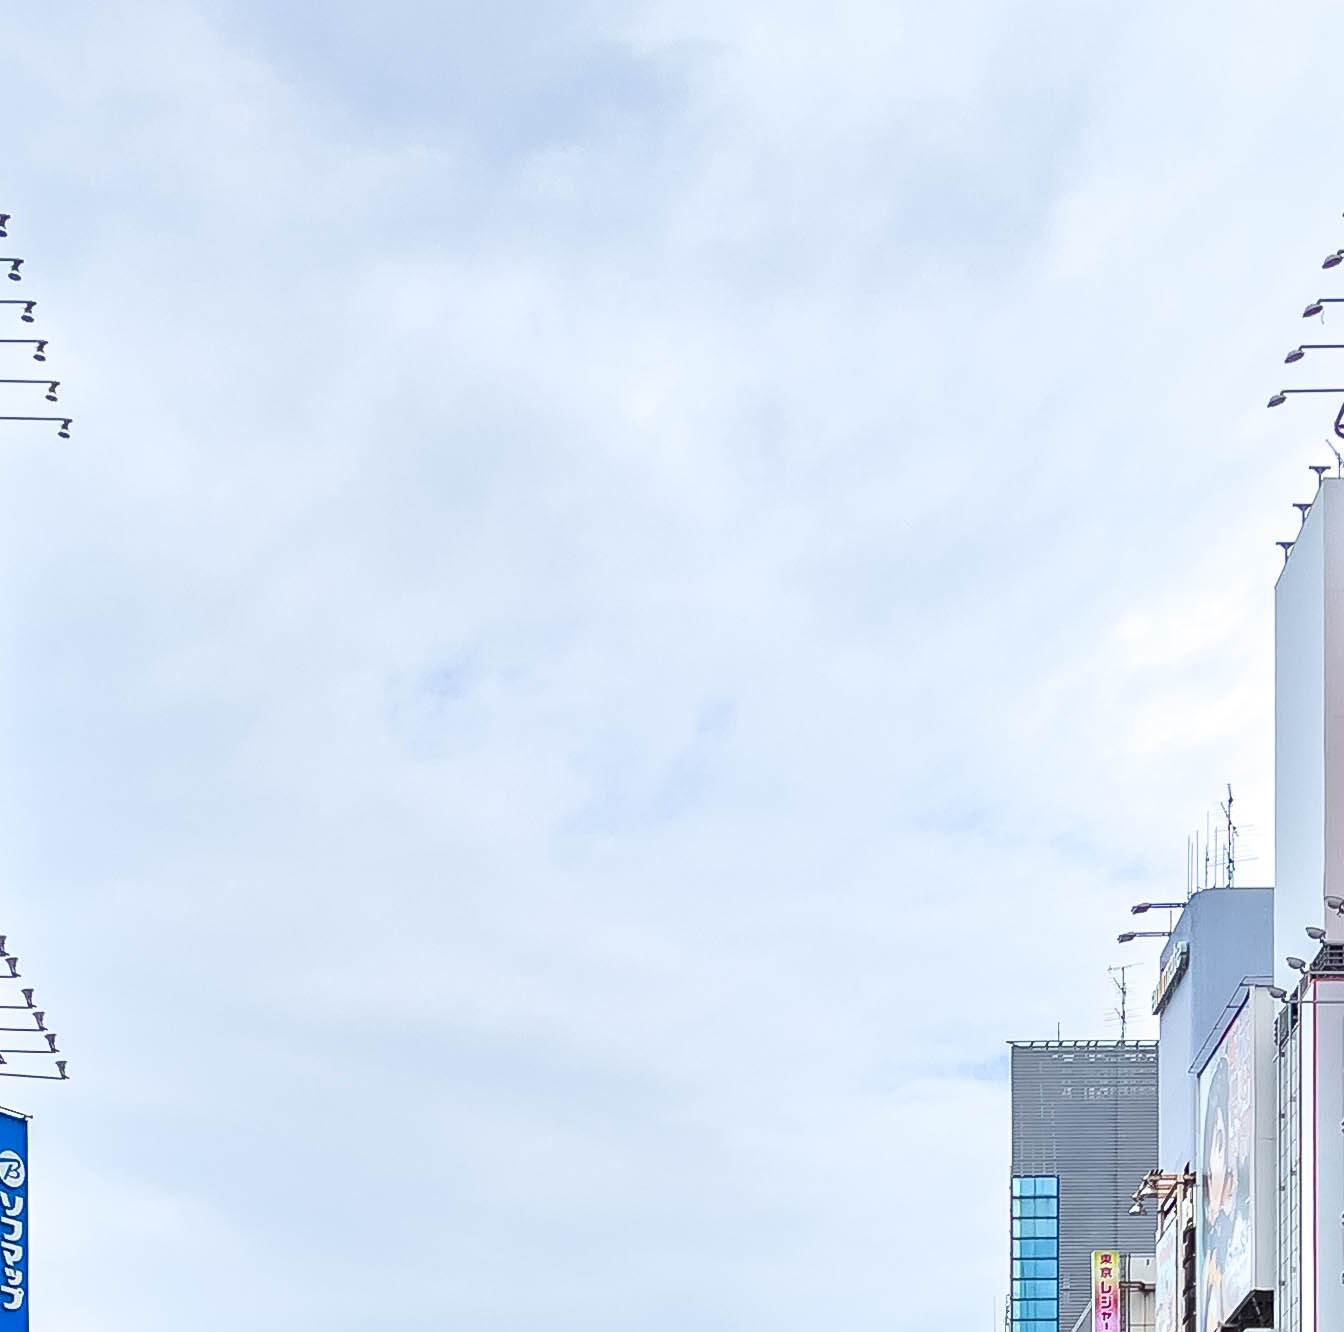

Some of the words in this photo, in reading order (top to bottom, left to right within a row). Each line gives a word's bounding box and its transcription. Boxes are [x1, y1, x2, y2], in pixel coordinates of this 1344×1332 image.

[0, 1190, 25, 1311] ソフマップ
